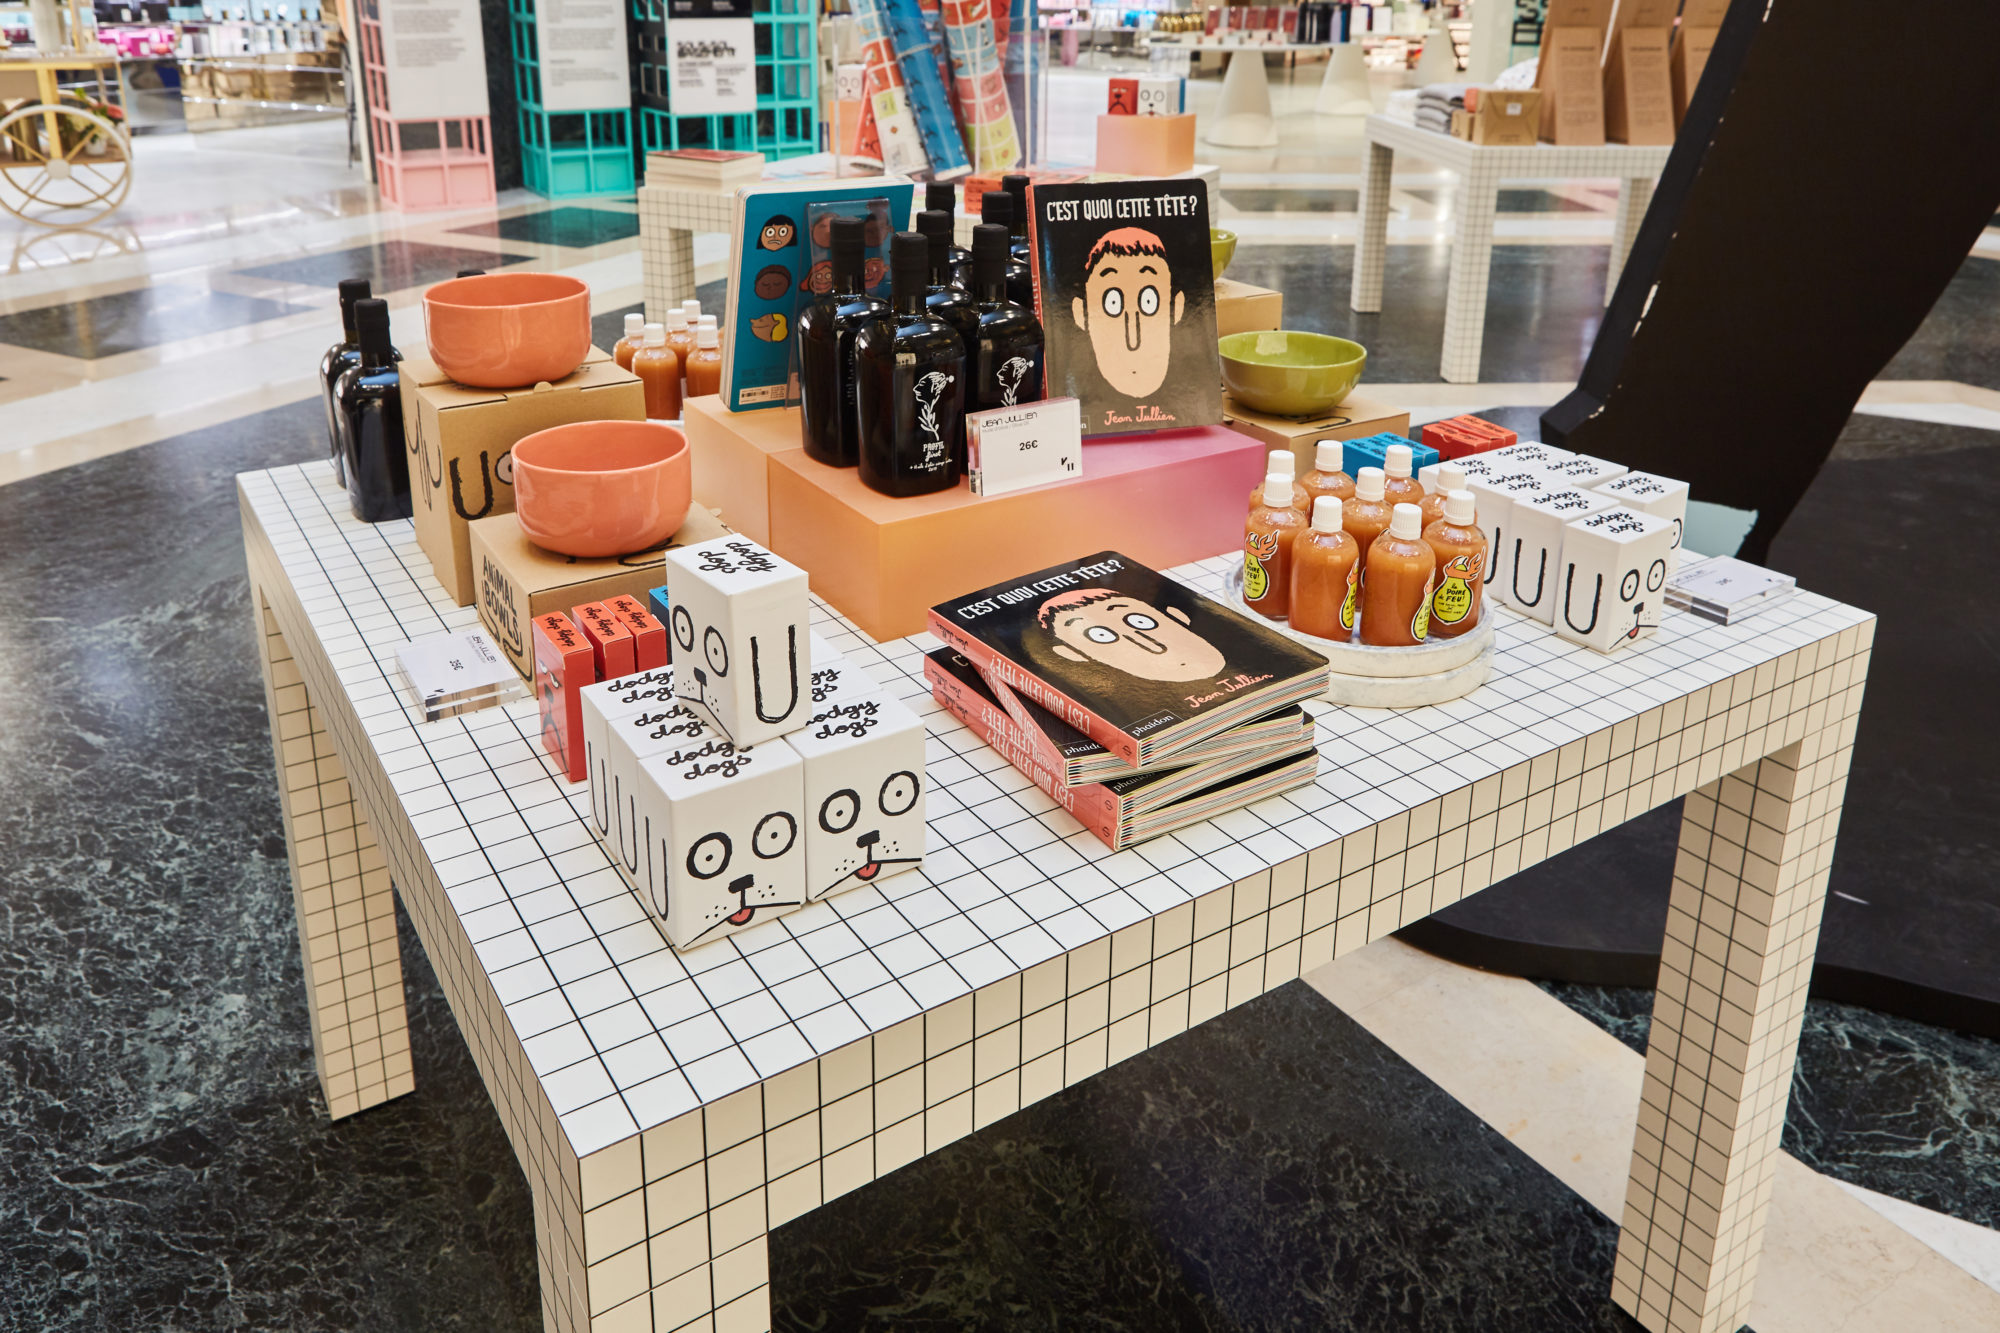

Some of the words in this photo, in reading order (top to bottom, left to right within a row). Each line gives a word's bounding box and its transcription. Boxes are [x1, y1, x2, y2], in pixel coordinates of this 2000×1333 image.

[1046, 199, 1080, 222] C'EST
[1083, 198, 1113, 221] QUOI
[1116, 197, 1151, 218] CETTE
[1104, 410, 1133, 426] Jean
[1135, 405, 1177, 422] Jullien
[1019, 440, 1039, 451] 26€
[698, 551, 741, 574] dogs
[725, 542, 778, 572] dodgy
[957, 598, 1001, 620] C'EST
[996, 586, 1039, 605] QUOI
[1032, 573, 1080, 594] CETTE
[484, 579, 520, 646] BOWLS
[1184, 691, 1225, 708] Jean
[1216, 674, 1274, 693] Jullien
[815, 717, 878, 739] dogs
[1131, 714, 1175, 737] phaidon
[683, 755, 753, 780] dogs
